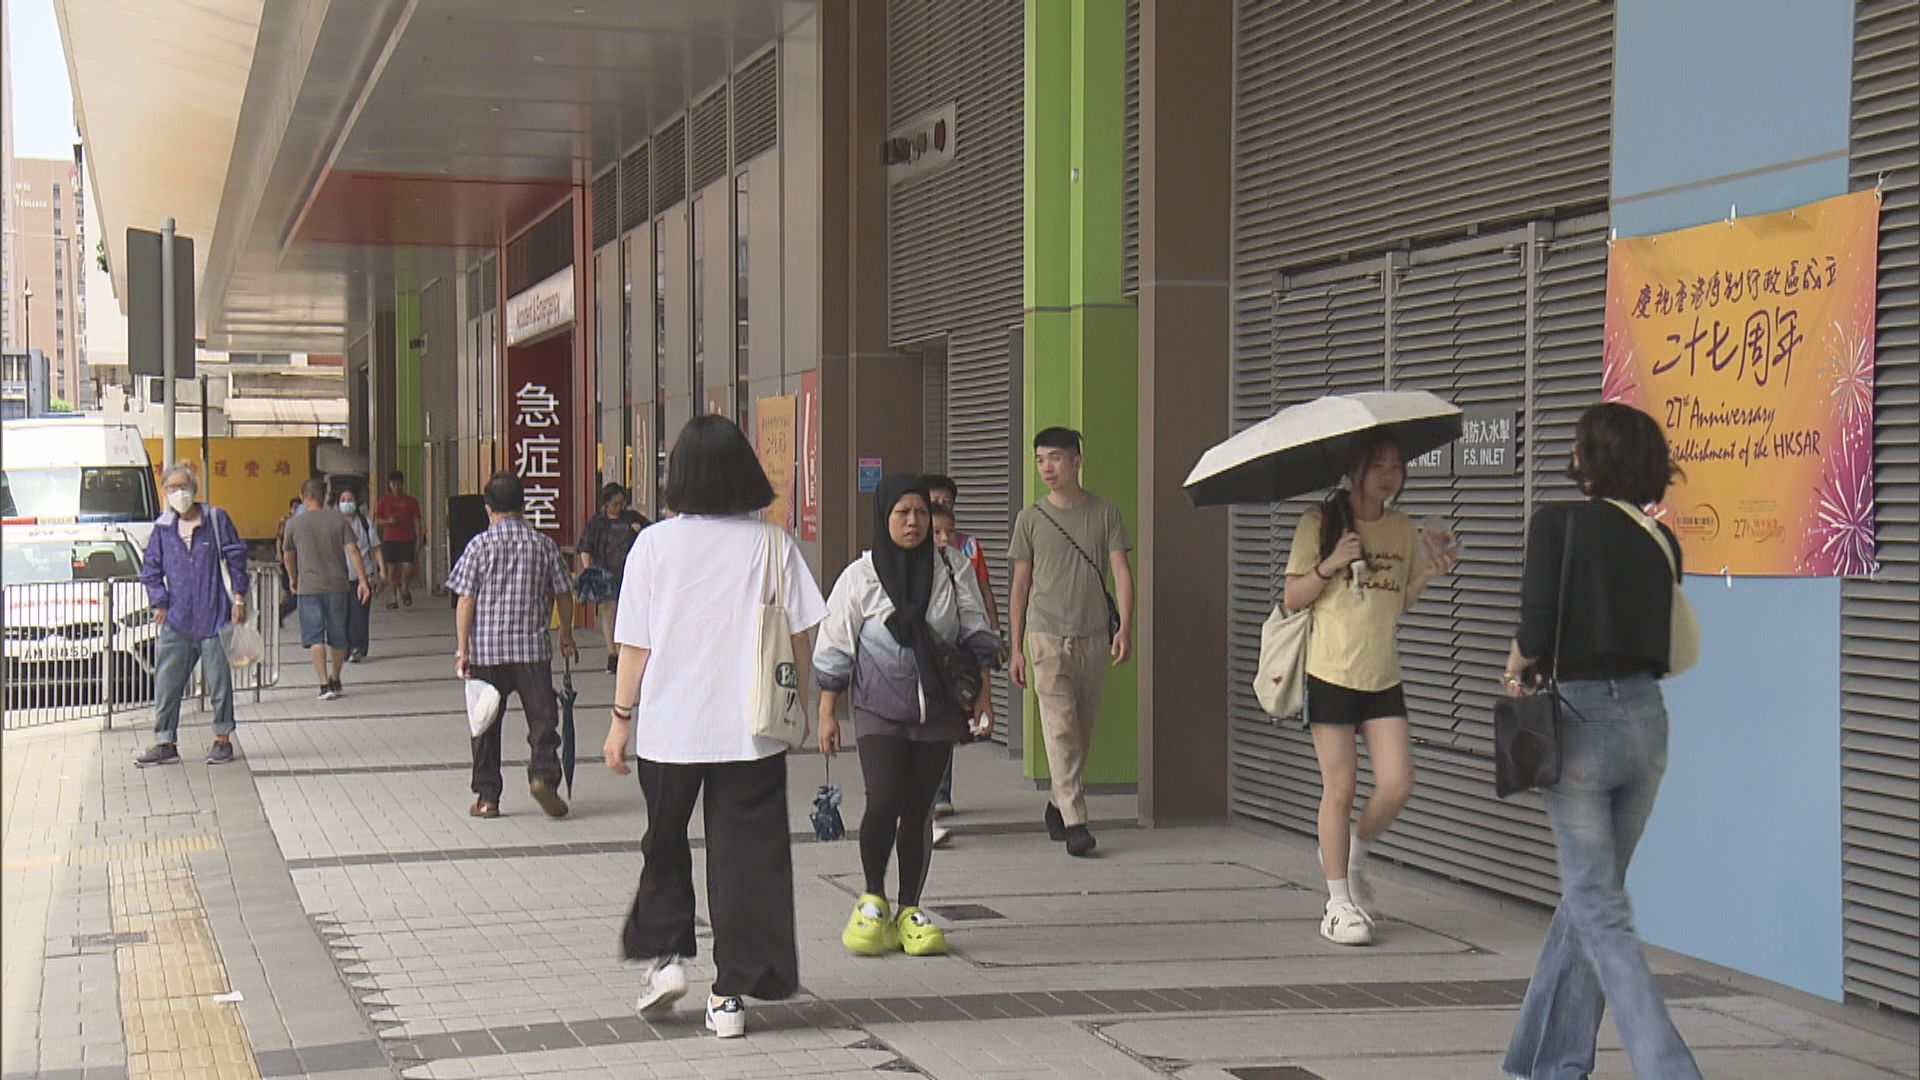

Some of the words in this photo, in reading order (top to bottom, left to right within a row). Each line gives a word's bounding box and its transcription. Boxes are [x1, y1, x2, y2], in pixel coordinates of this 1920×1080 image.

[1652, 306, 1803, 387] 二十七周年
[1690, 396, 1776, 435] Anniversary
[515, 381, 560, 529] 急症室
[1463, 447, 1478, 466] F.S.
[1480, 448, 1505, 466] INLET
[1739, 436, 1751, 468] of
[1754, 435, 1768, 460] the
[1773, 430, 1821, 459] HKSAR
